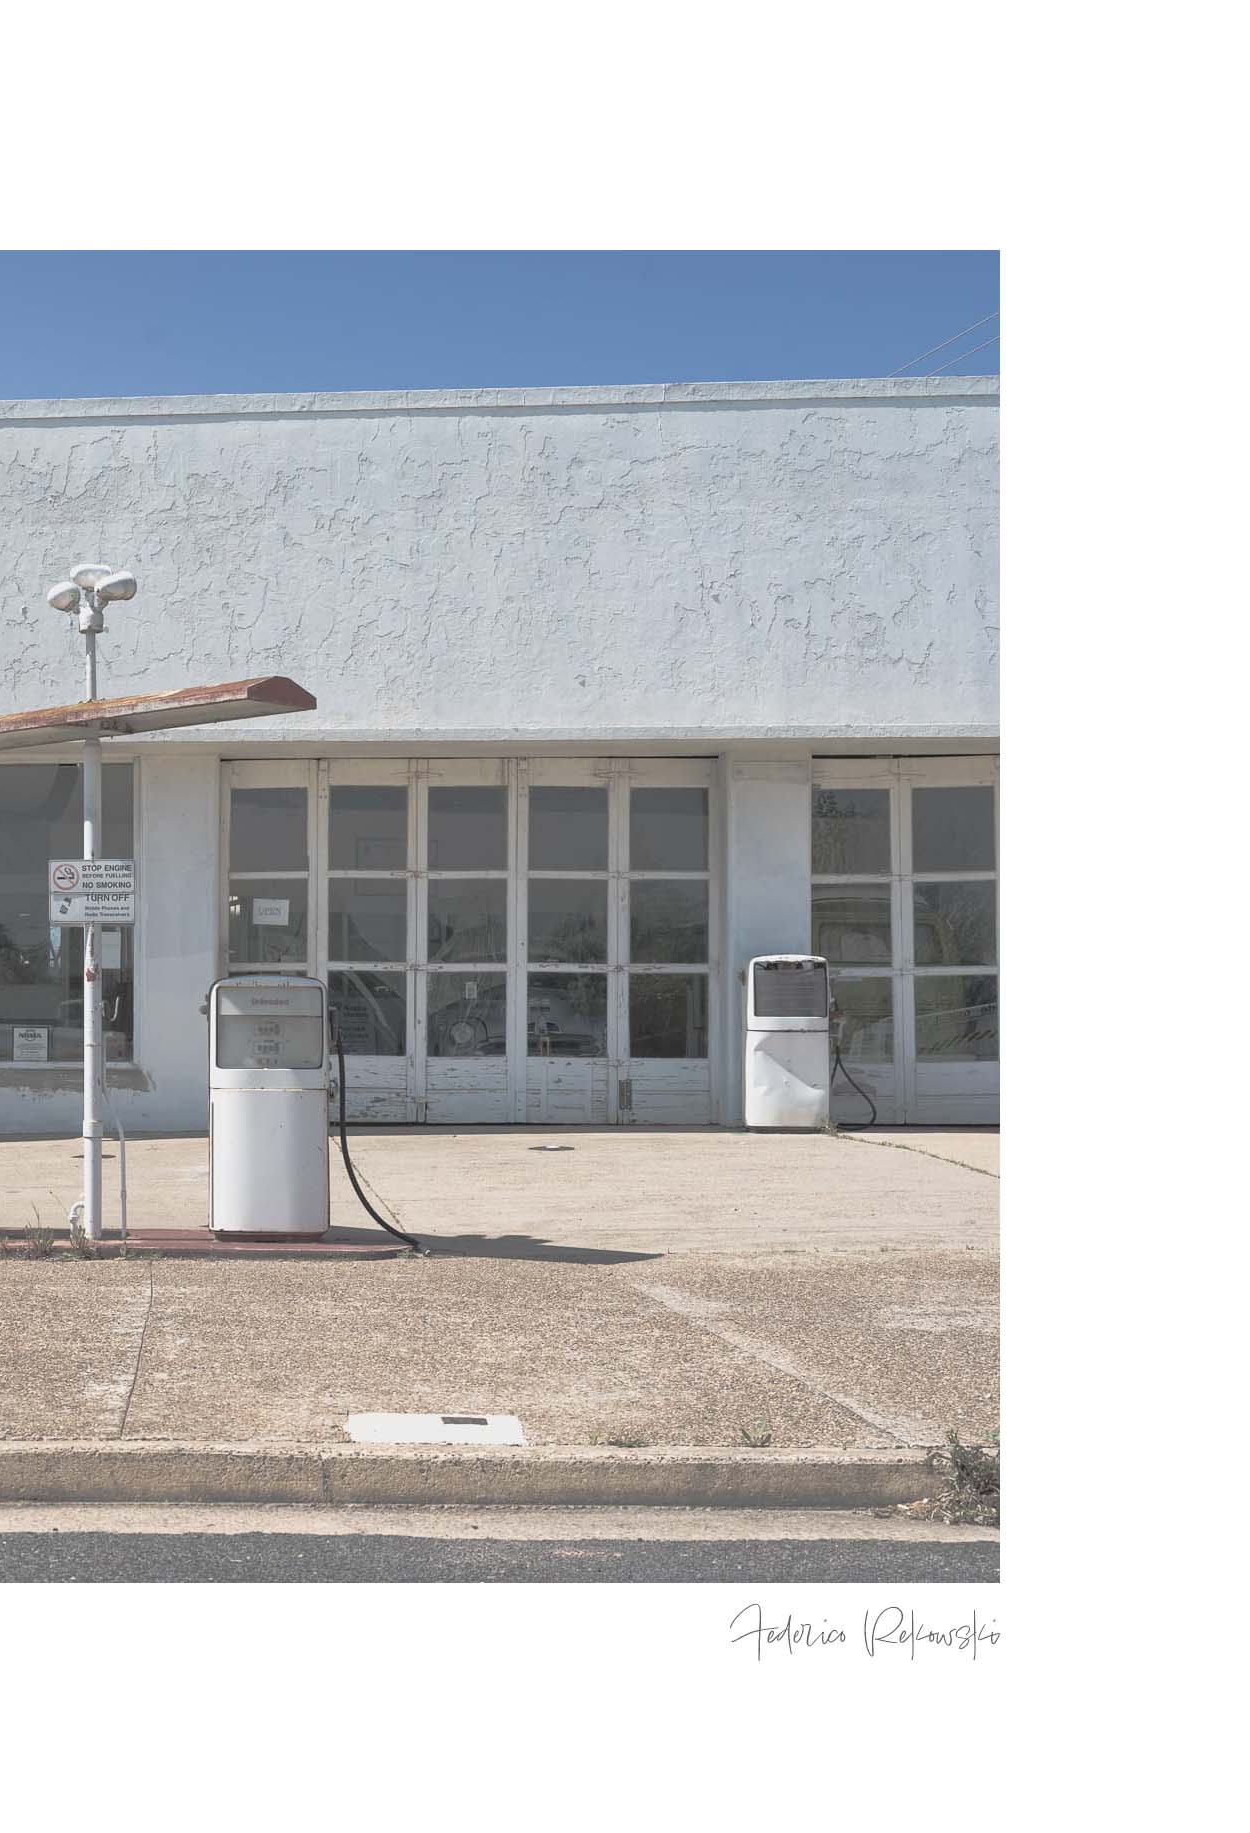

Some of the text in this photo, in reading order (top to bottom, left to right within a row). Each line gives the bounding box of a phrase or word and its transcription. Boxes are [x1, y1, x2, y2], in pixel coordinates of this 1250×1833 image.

[81, 864, 132, 872] STOP ENGINE
[82, 881, 132, 889] NO SMOKING
[85, 893, 130, 902] TURN OFF
